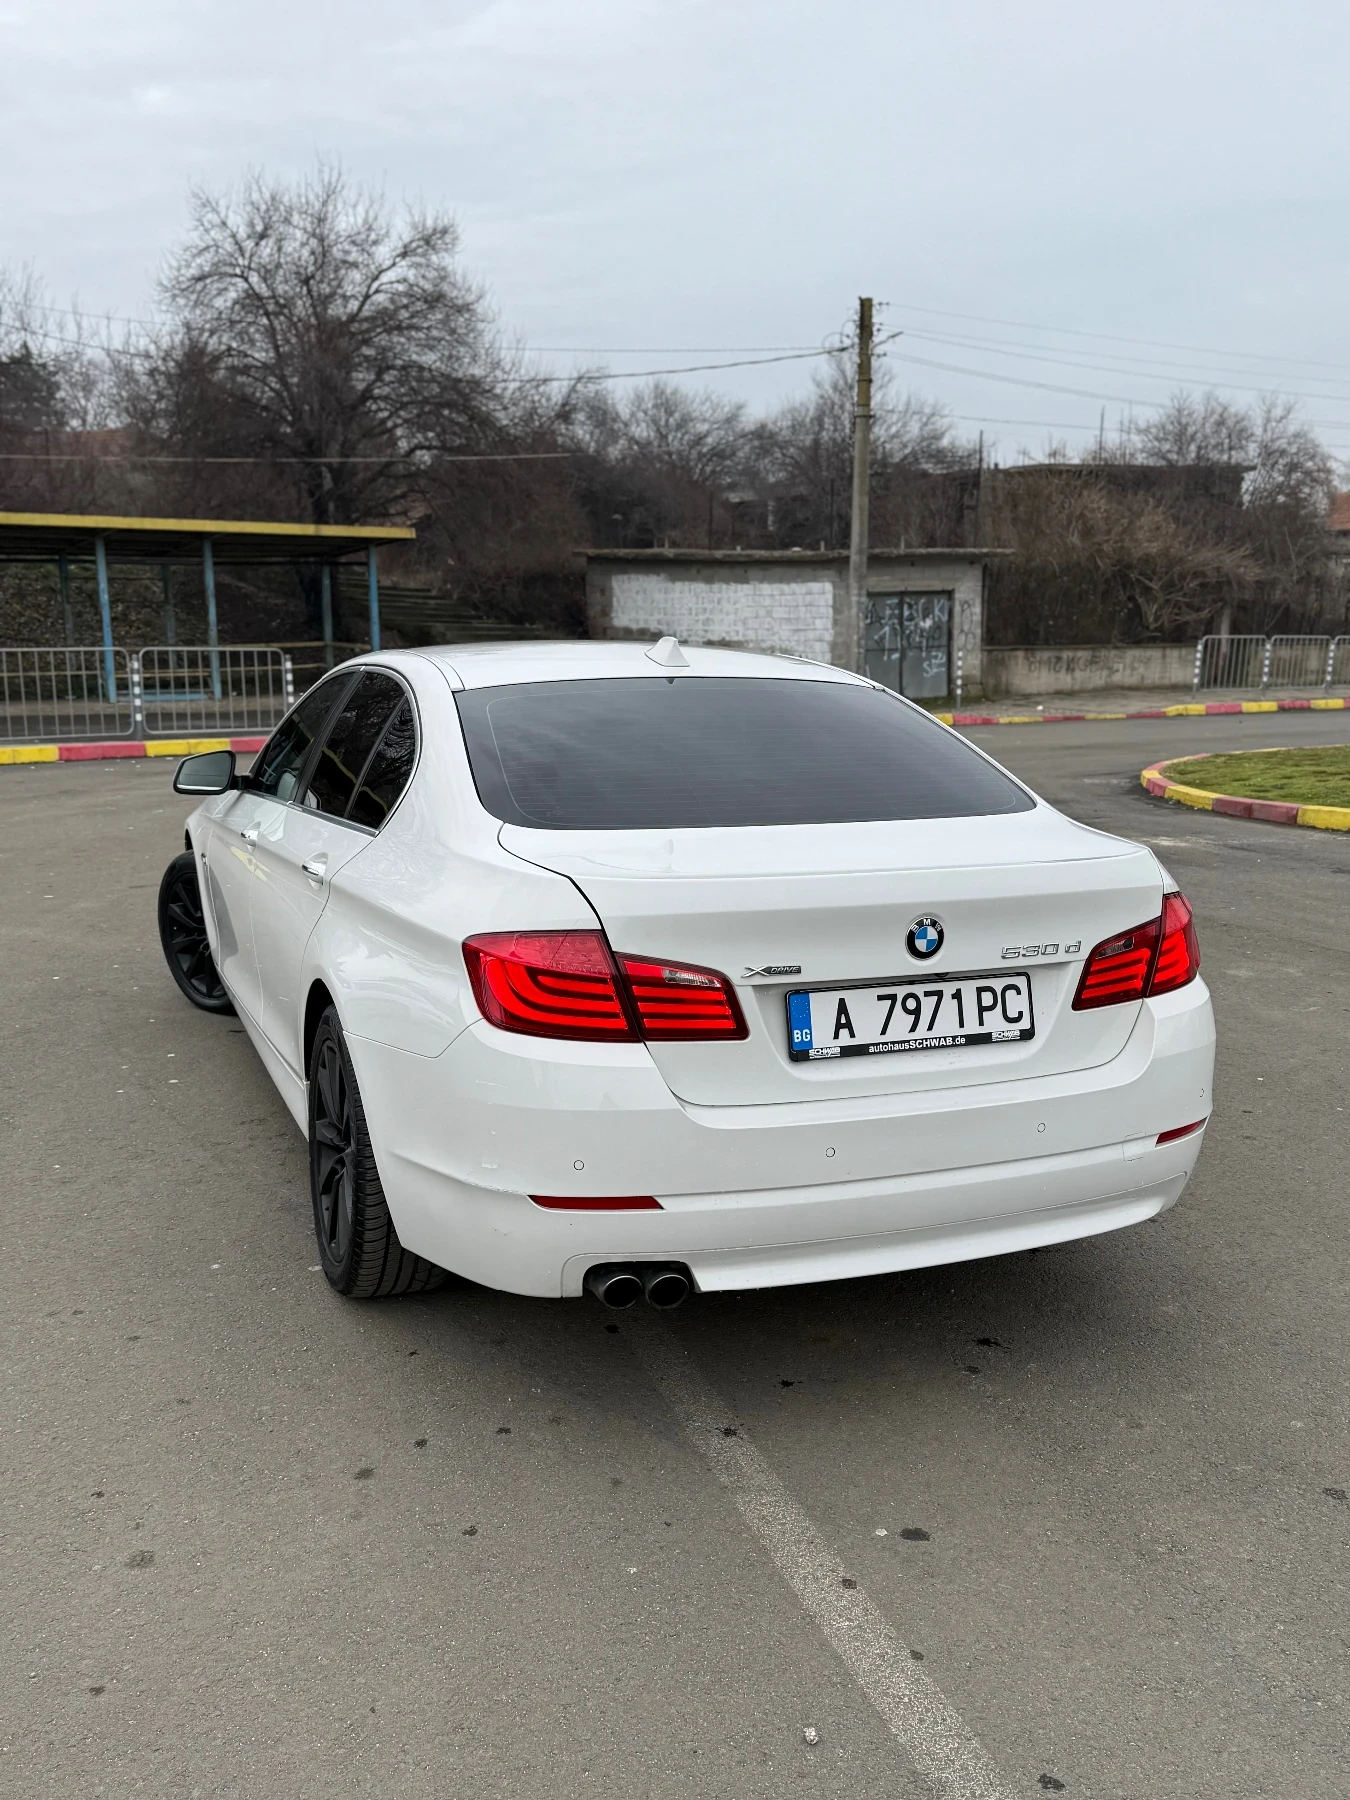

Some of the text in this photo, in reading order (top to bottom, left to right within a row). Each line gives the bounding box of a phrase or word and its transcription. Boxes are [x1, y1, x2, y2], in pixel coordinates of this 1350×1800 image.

[1001, 940, 1082, 959] 530 d
[832, 997, 856, 1040] A
[793, 1029, 811, 1043] BG
[868, 1035, 966, 1053] autohausSCHWAB.de
